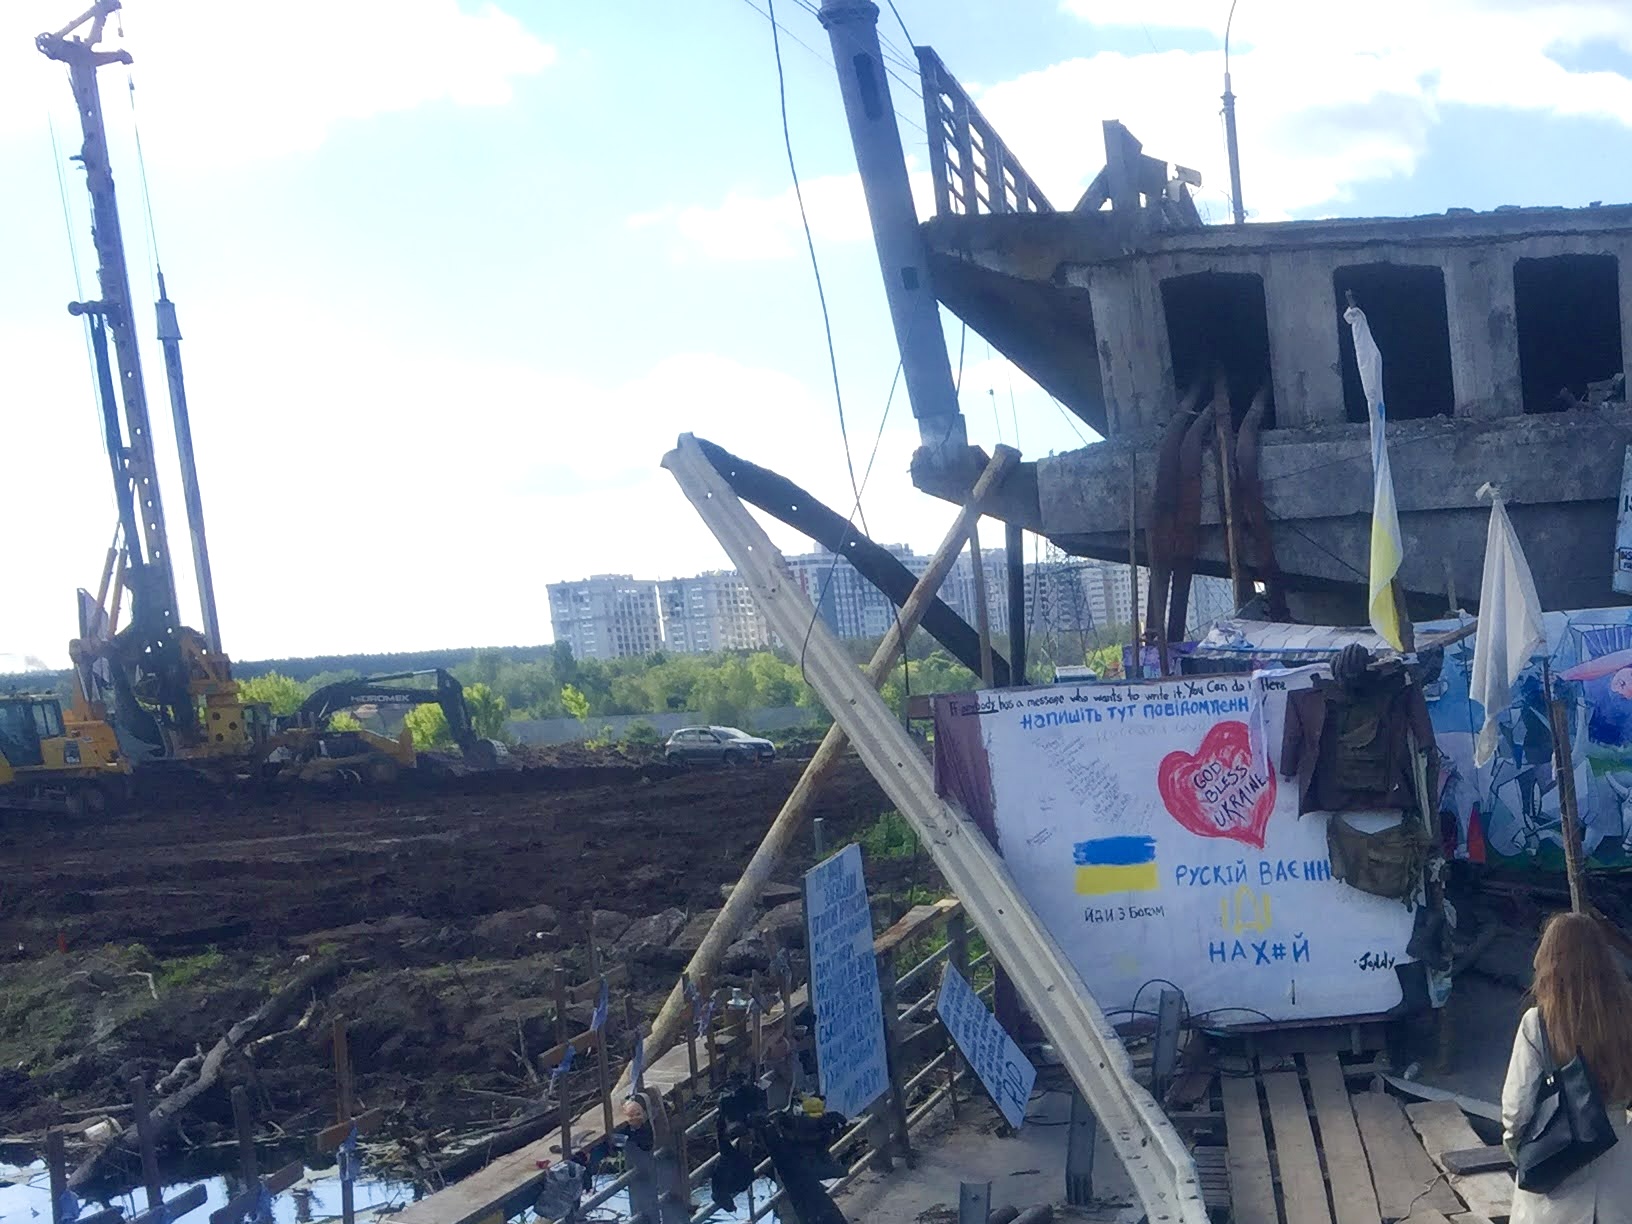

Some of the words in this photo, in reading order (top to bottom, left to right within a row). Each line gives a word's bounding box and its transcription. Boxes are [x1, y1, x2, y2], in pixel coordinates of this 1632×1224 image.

[998, 695, 1014, 711] has
[1016, 700, 1024, 708] a
[1027, 694, 1065, 708] message
[1070, 688, 1088, 703] who
[1093, 688, 1123, 702] wants
[1127, 686, 1140, 701] to
[1145, 686, 1169, 701] write
[1184, 681, 1204, 699] You
[1206, 681, 1228, 693] Can
[1231, 680, 1245, 692] do
[1193, 762, 1222, 789] GOD
[1205, 765, 1248, 804] BLESS
[1214, 773, 1267, 827] UKRAINE
[1175, 859, 1248, 886] РУСКІЙ
